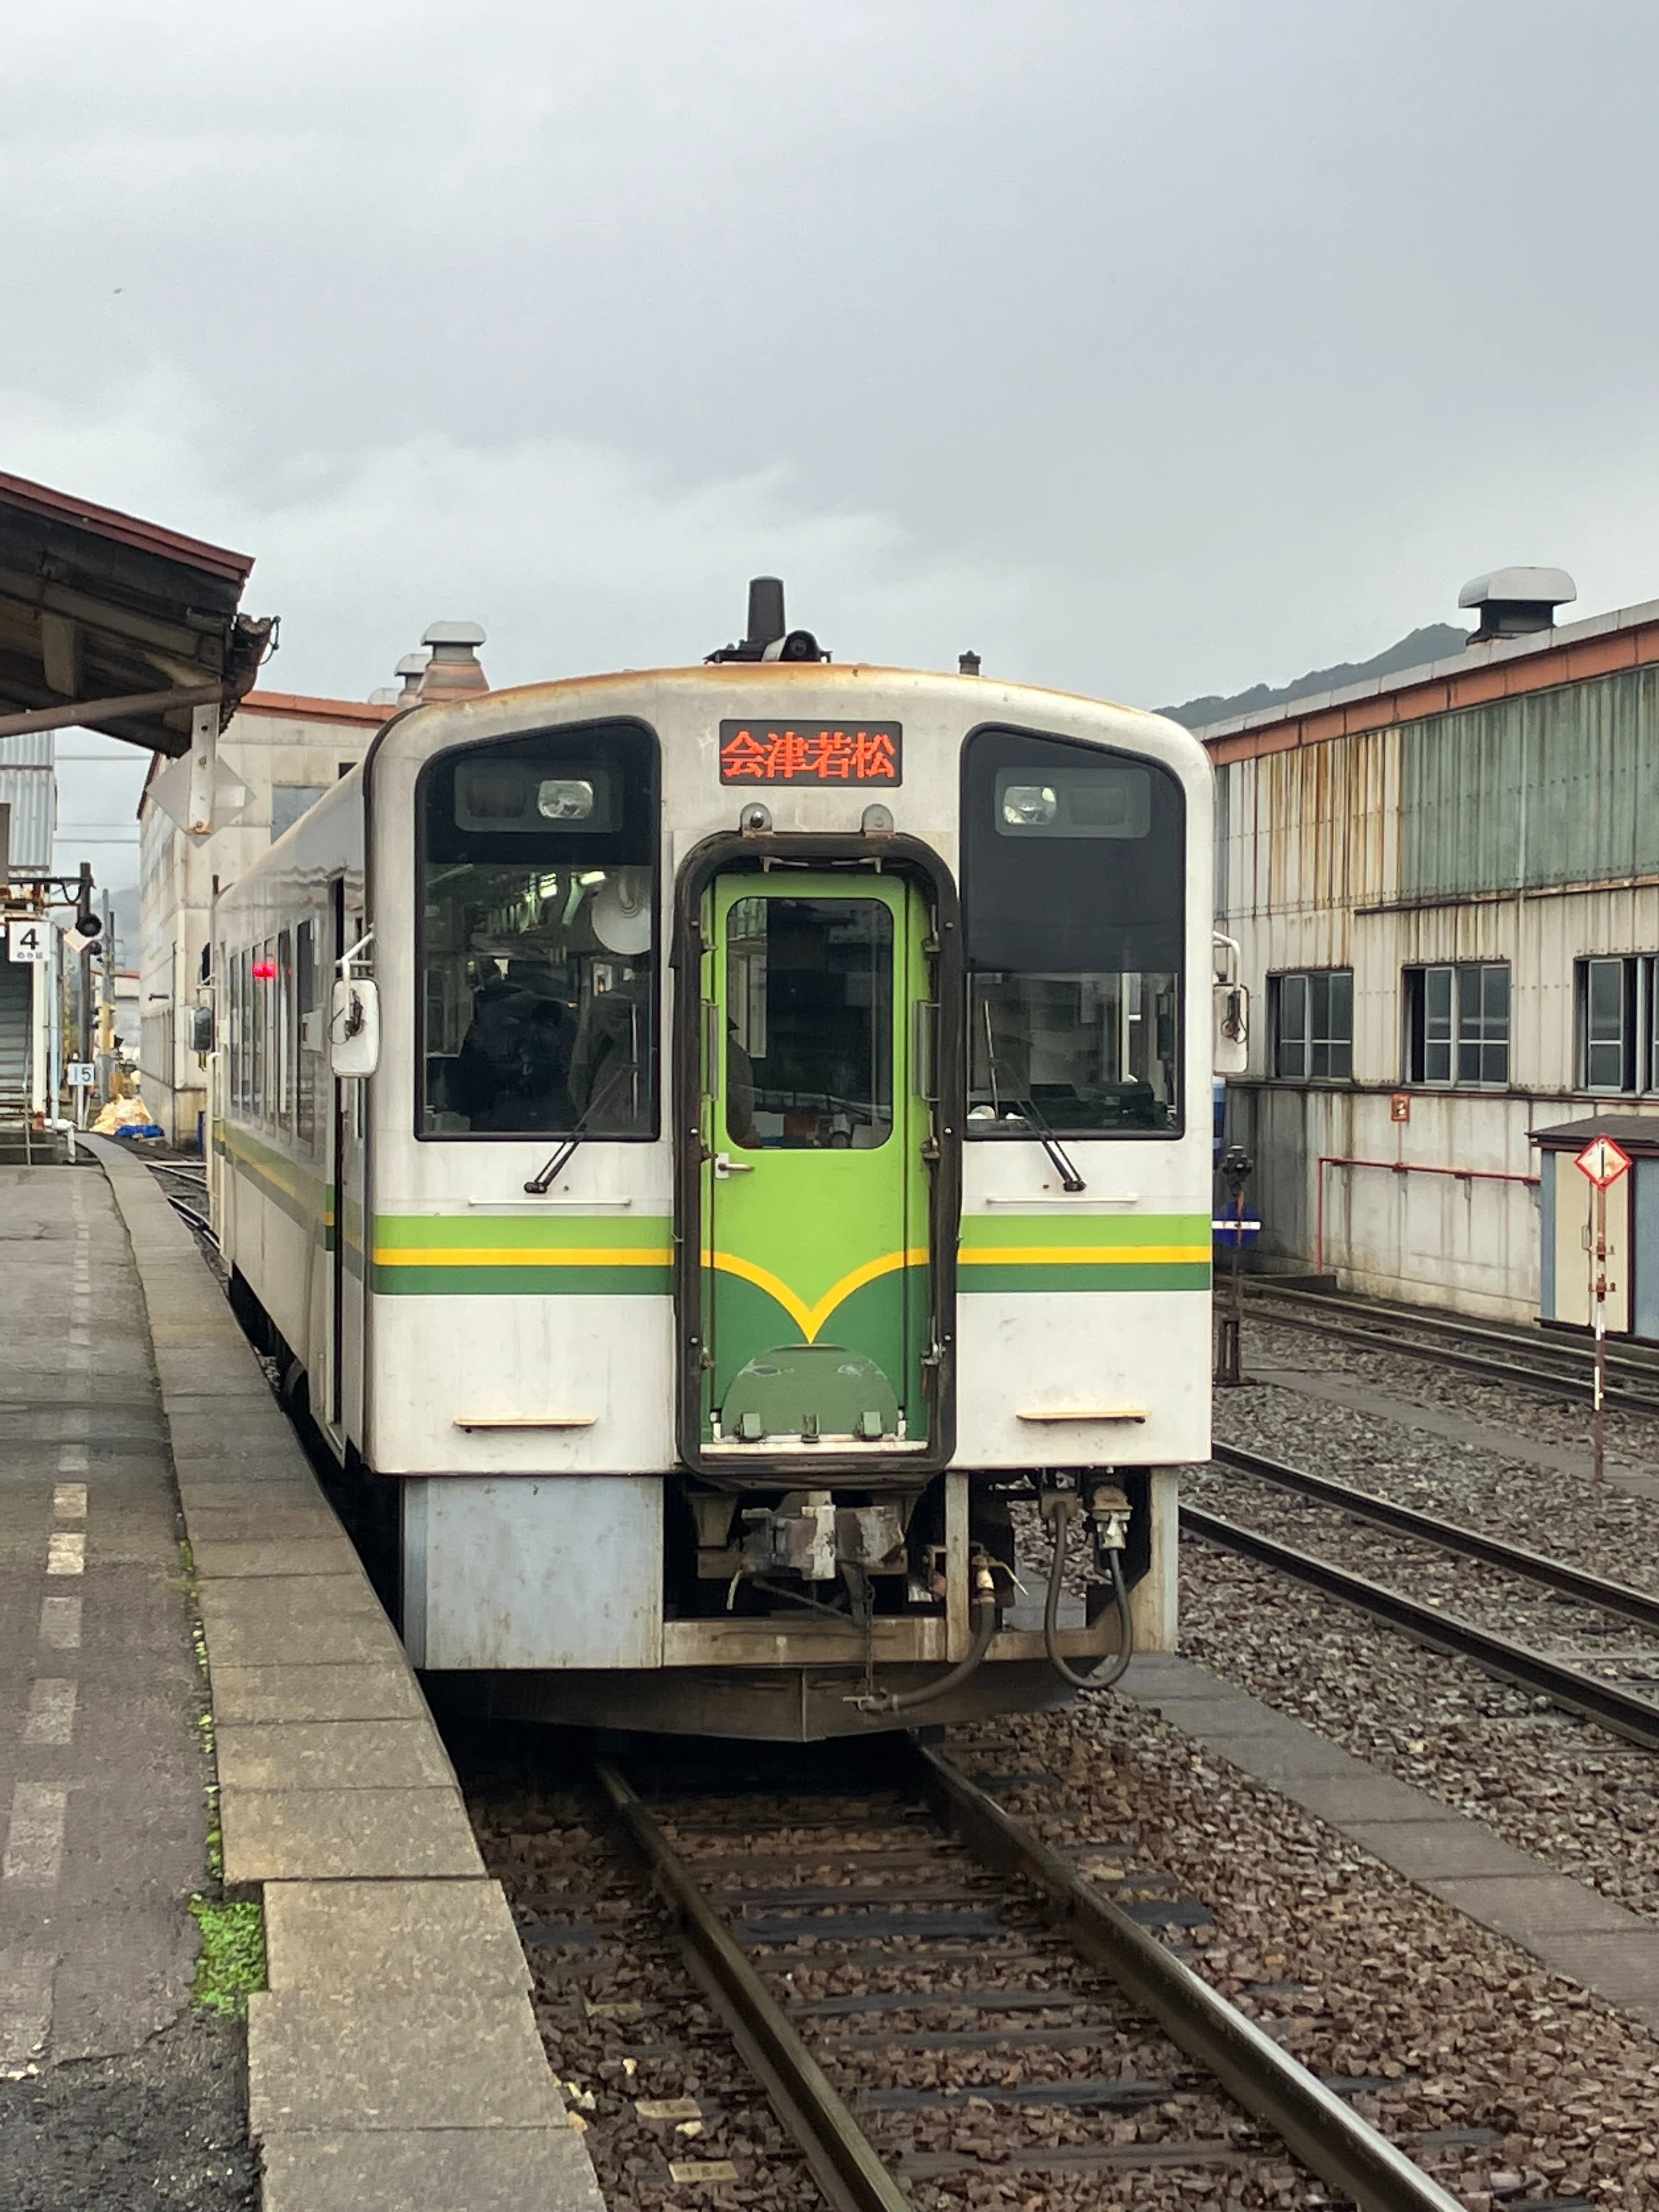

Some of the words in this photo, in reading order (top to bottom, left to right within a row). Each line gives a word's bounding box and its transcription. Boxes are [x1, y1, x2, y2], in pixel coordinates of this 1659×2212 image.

[721, 731, 896, 778] 会津若松
[20, 928, 39, 950] 4
[74, 1066, 92, 1082] 15
